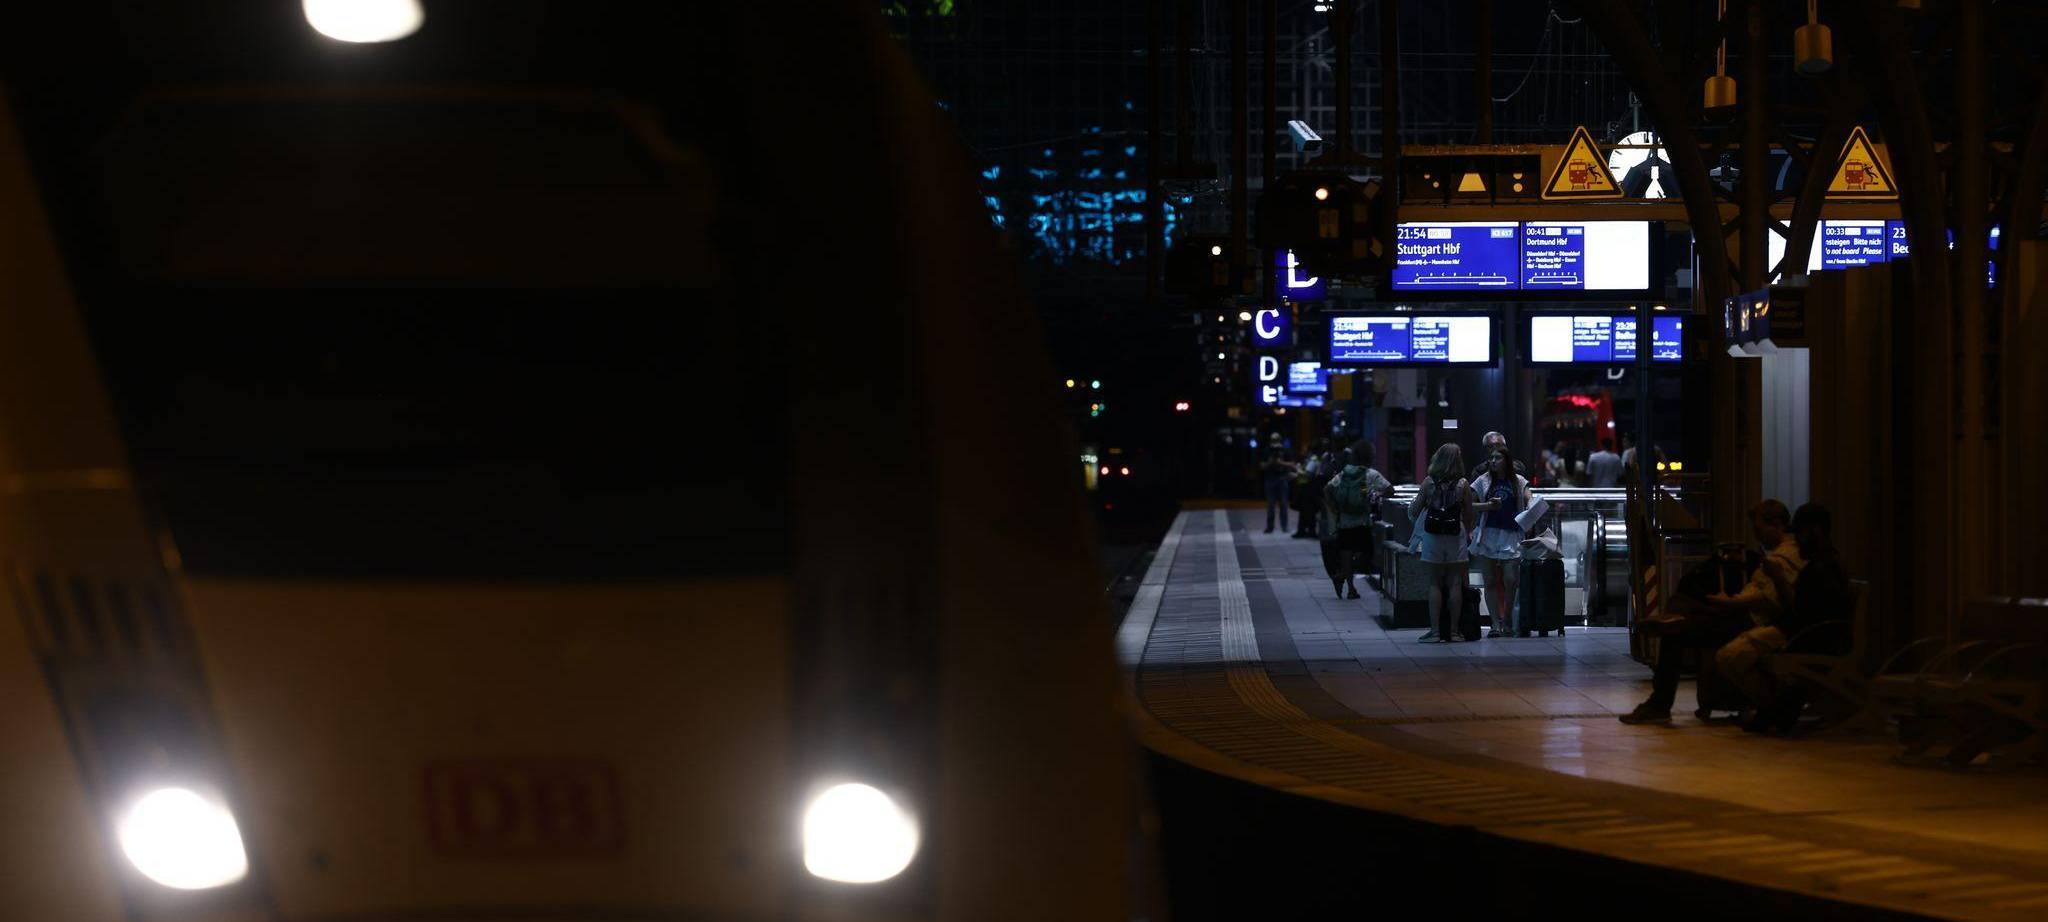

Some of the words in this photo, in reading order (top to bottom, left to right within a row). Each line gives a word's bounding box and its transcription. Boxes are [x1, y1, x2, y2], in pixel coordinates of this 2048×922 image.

[1397, 228, 1426, 239] 21:54
[1397, 243, 1441, 256] Stuttgart
[1443, 243, 1460, 254] Hbf
[1255, 308, 1281, 339] C
[1259, 355, 1278, 381] D
[449, 769, 602, 843] DB
